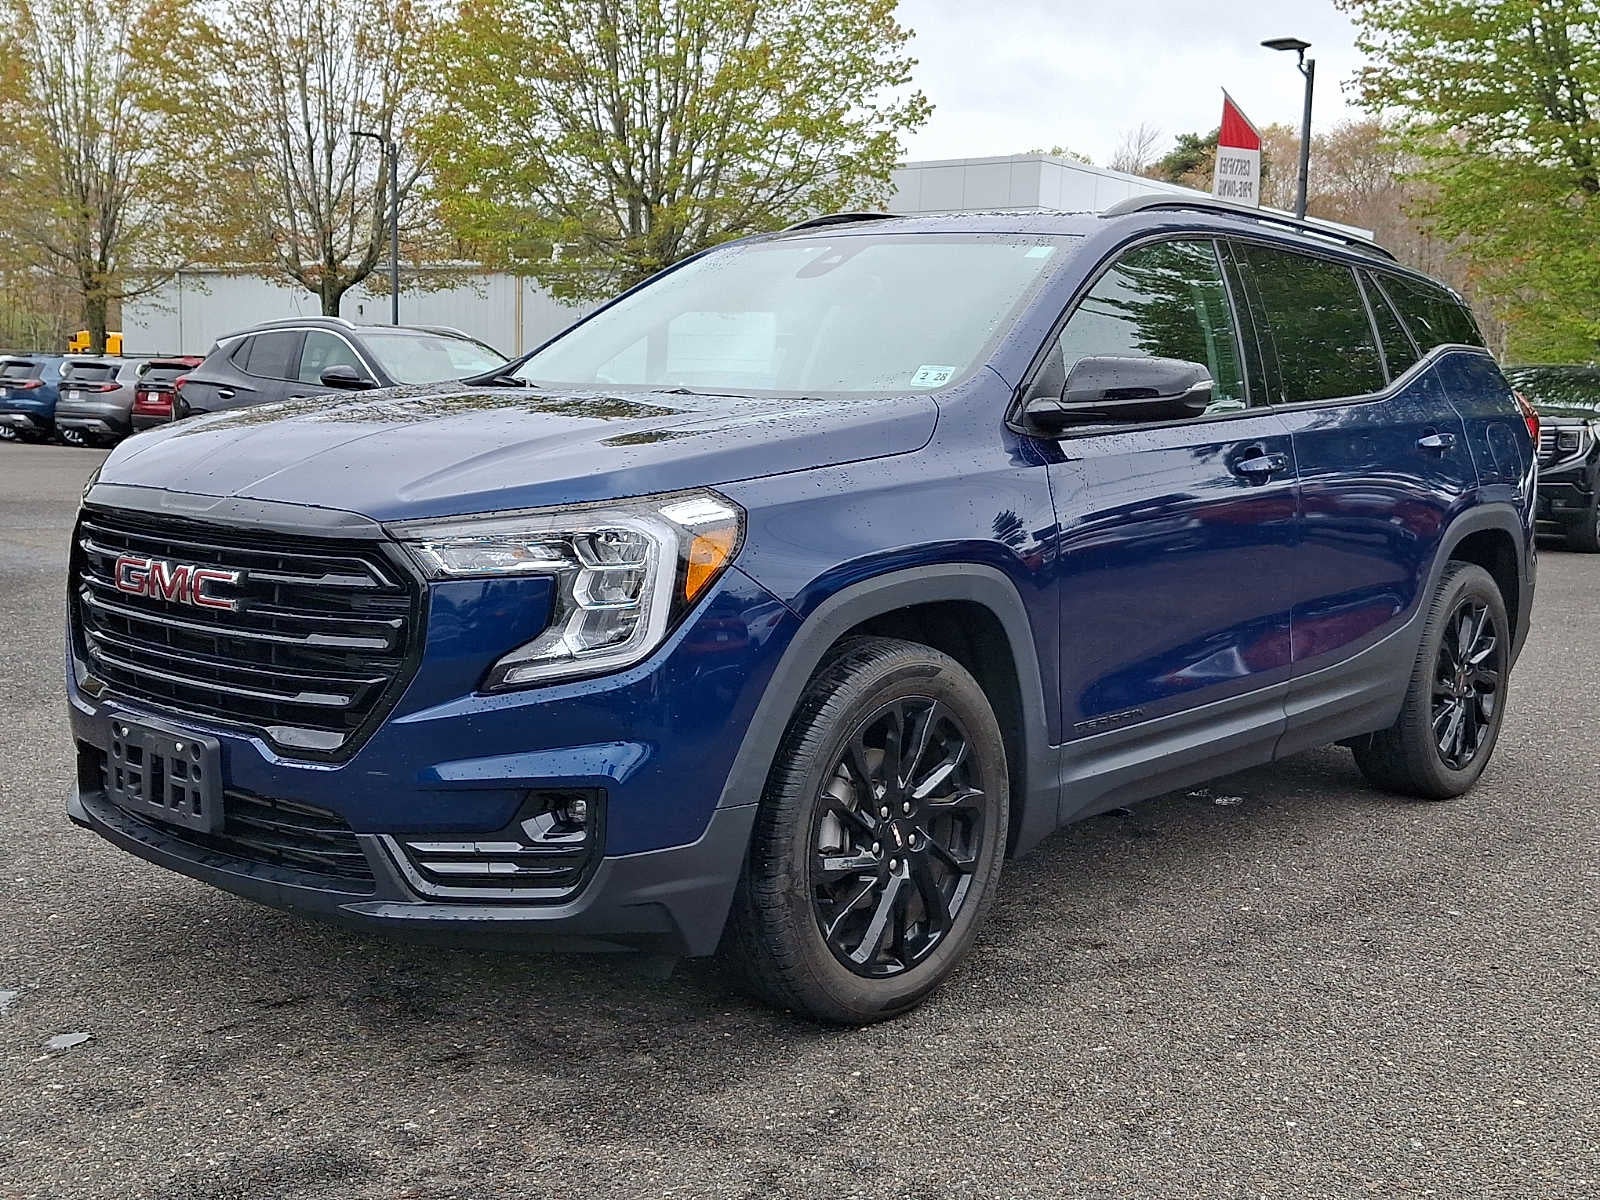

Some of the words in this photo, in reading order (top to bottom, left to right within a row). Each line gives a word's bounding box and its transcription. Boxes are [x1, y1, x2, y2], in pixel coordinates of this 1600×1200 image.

[919, 371, 929, 380] 2
[933, 372, 948, 381] 28
[115, 554, 241, 613] GMC
